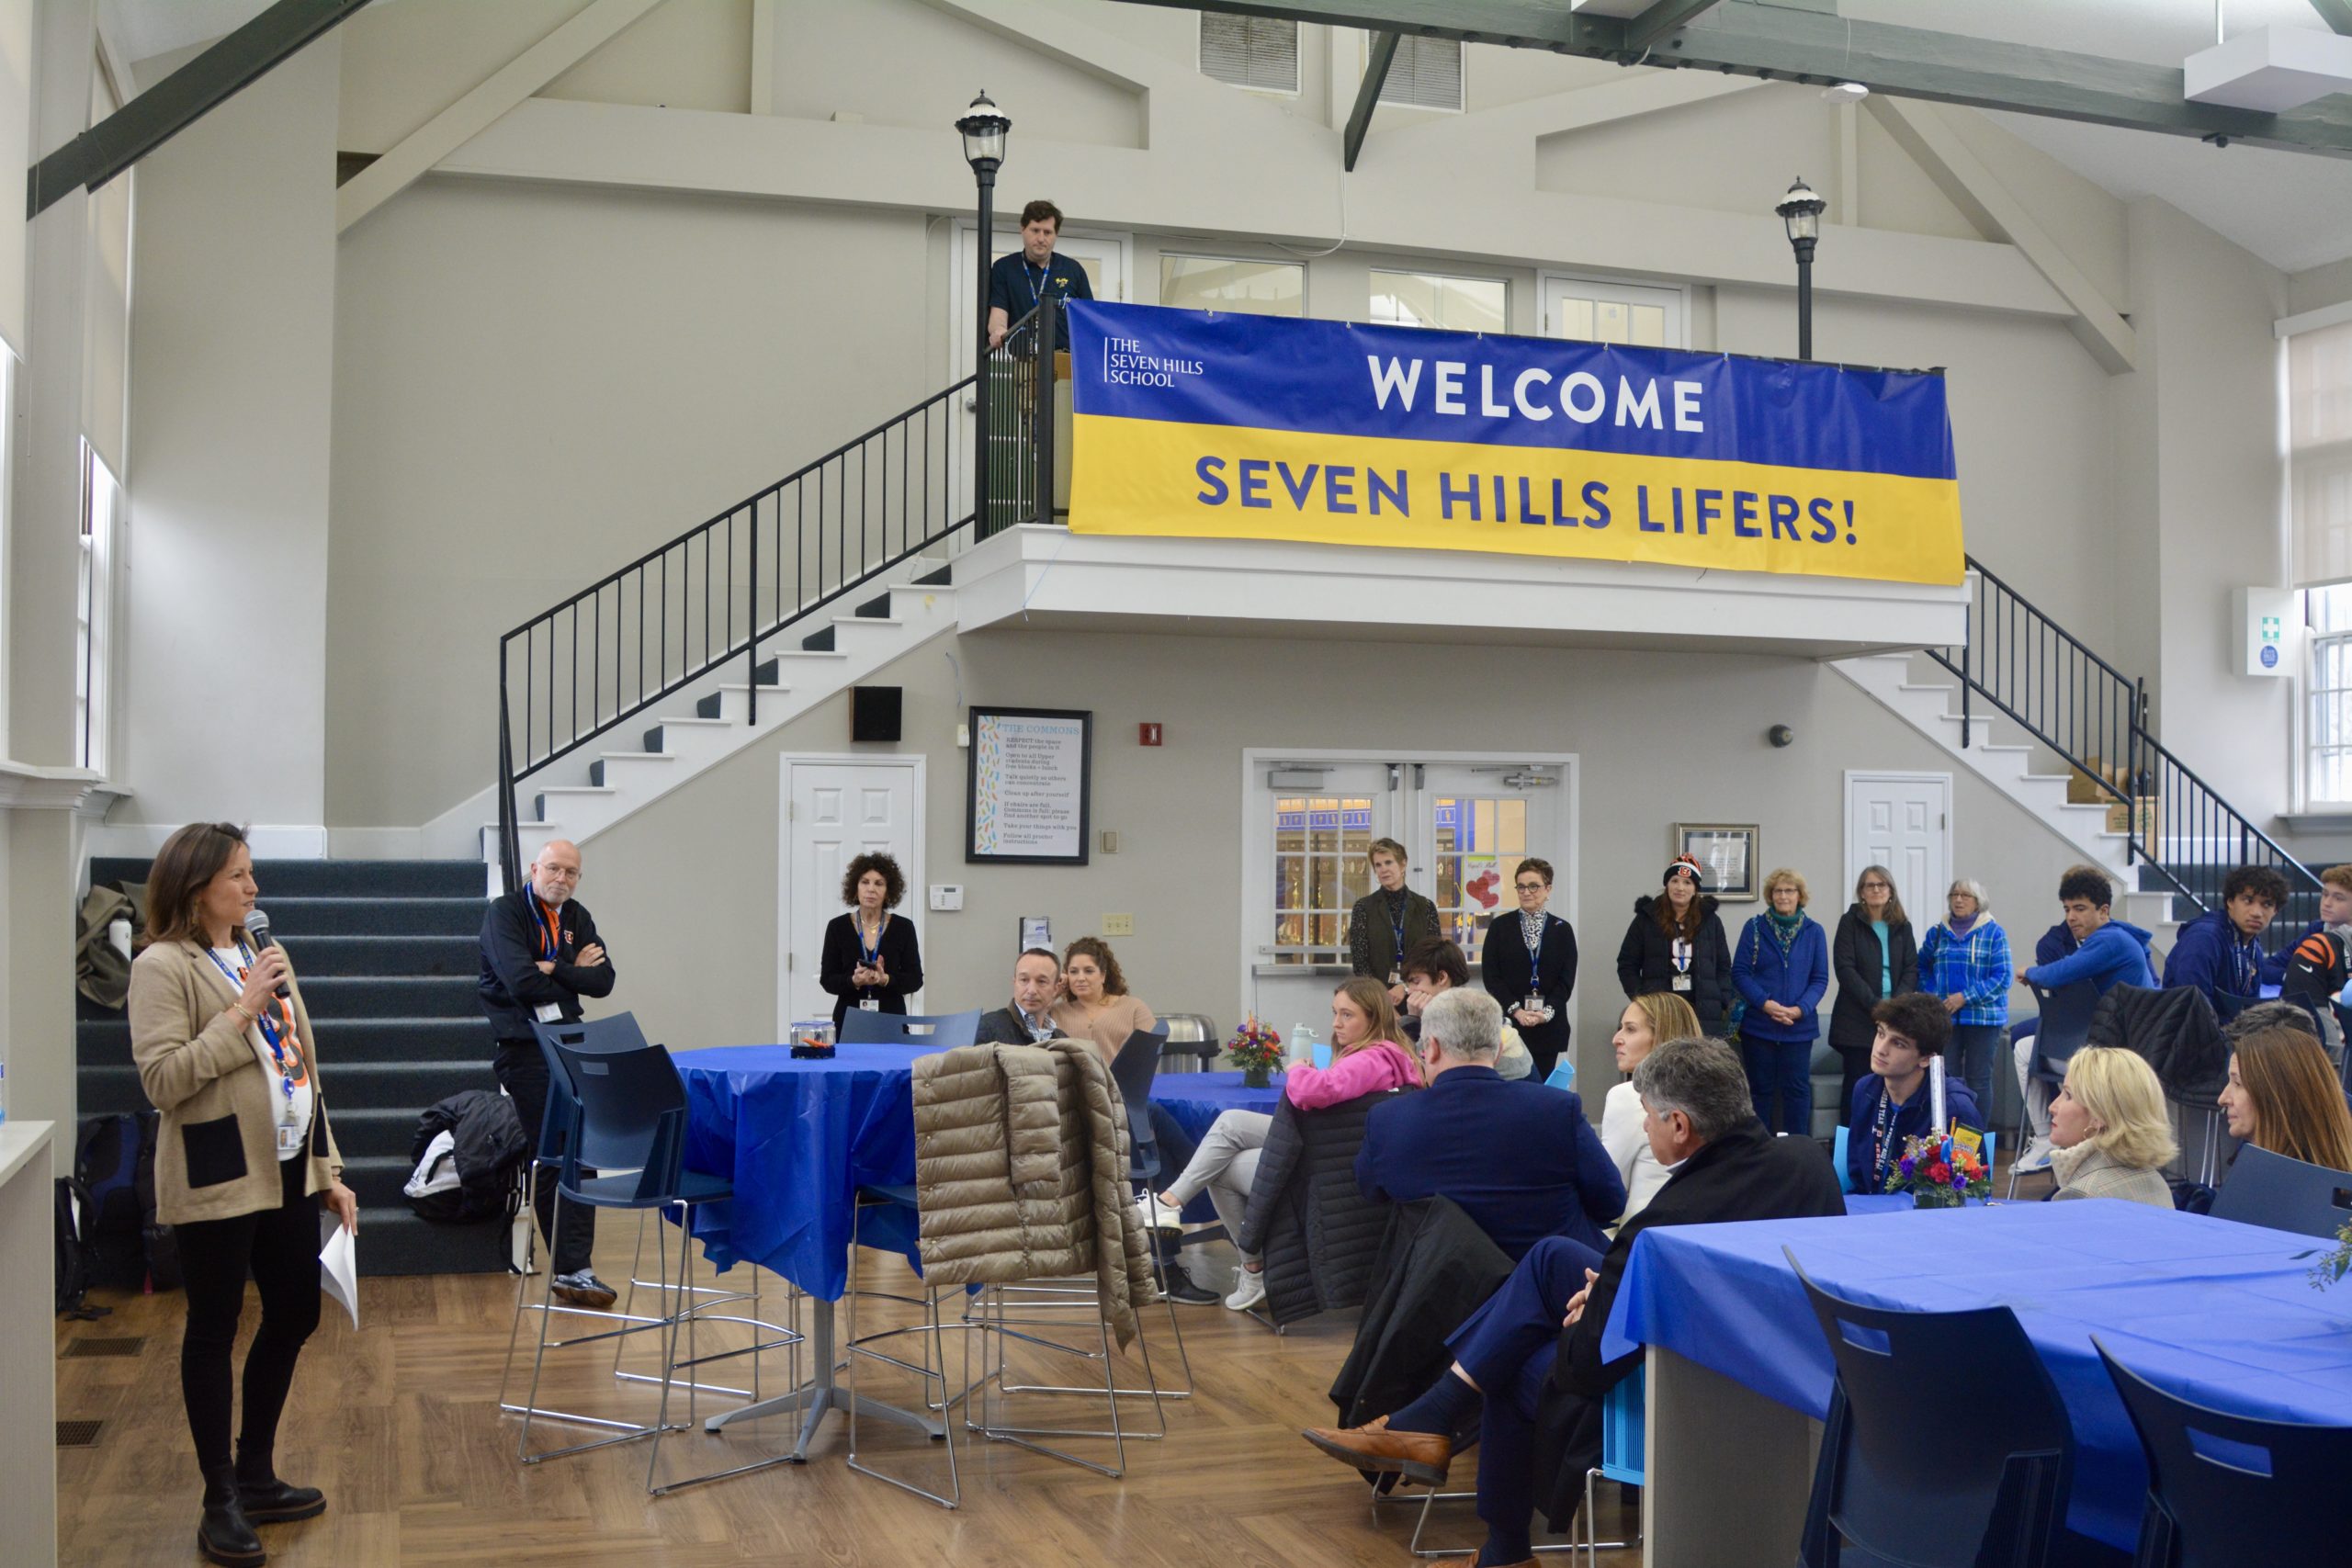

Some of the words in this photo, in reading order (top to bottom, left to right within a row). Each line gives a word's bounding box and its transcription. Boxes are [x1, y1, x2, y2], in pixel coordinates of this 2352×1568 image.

[1110, 337, 1141, 353] THE
[1110, 354, 1159, 370] SEVEN
[1163, 358, 1204, 375] HILLS
[1110, 370, 1175, 387] SCHOOL
[1367, 355, 1704, 433] WELCOME
[1196, 455, 1410, 518] SEVEN
[1440, 471, 1611, 530] HILLS
[1637, 484, 1858, 545] LIFERS!
[1001, 723, 1023, 733] THE
[1026, 725, 1080, 735] COMMONS
